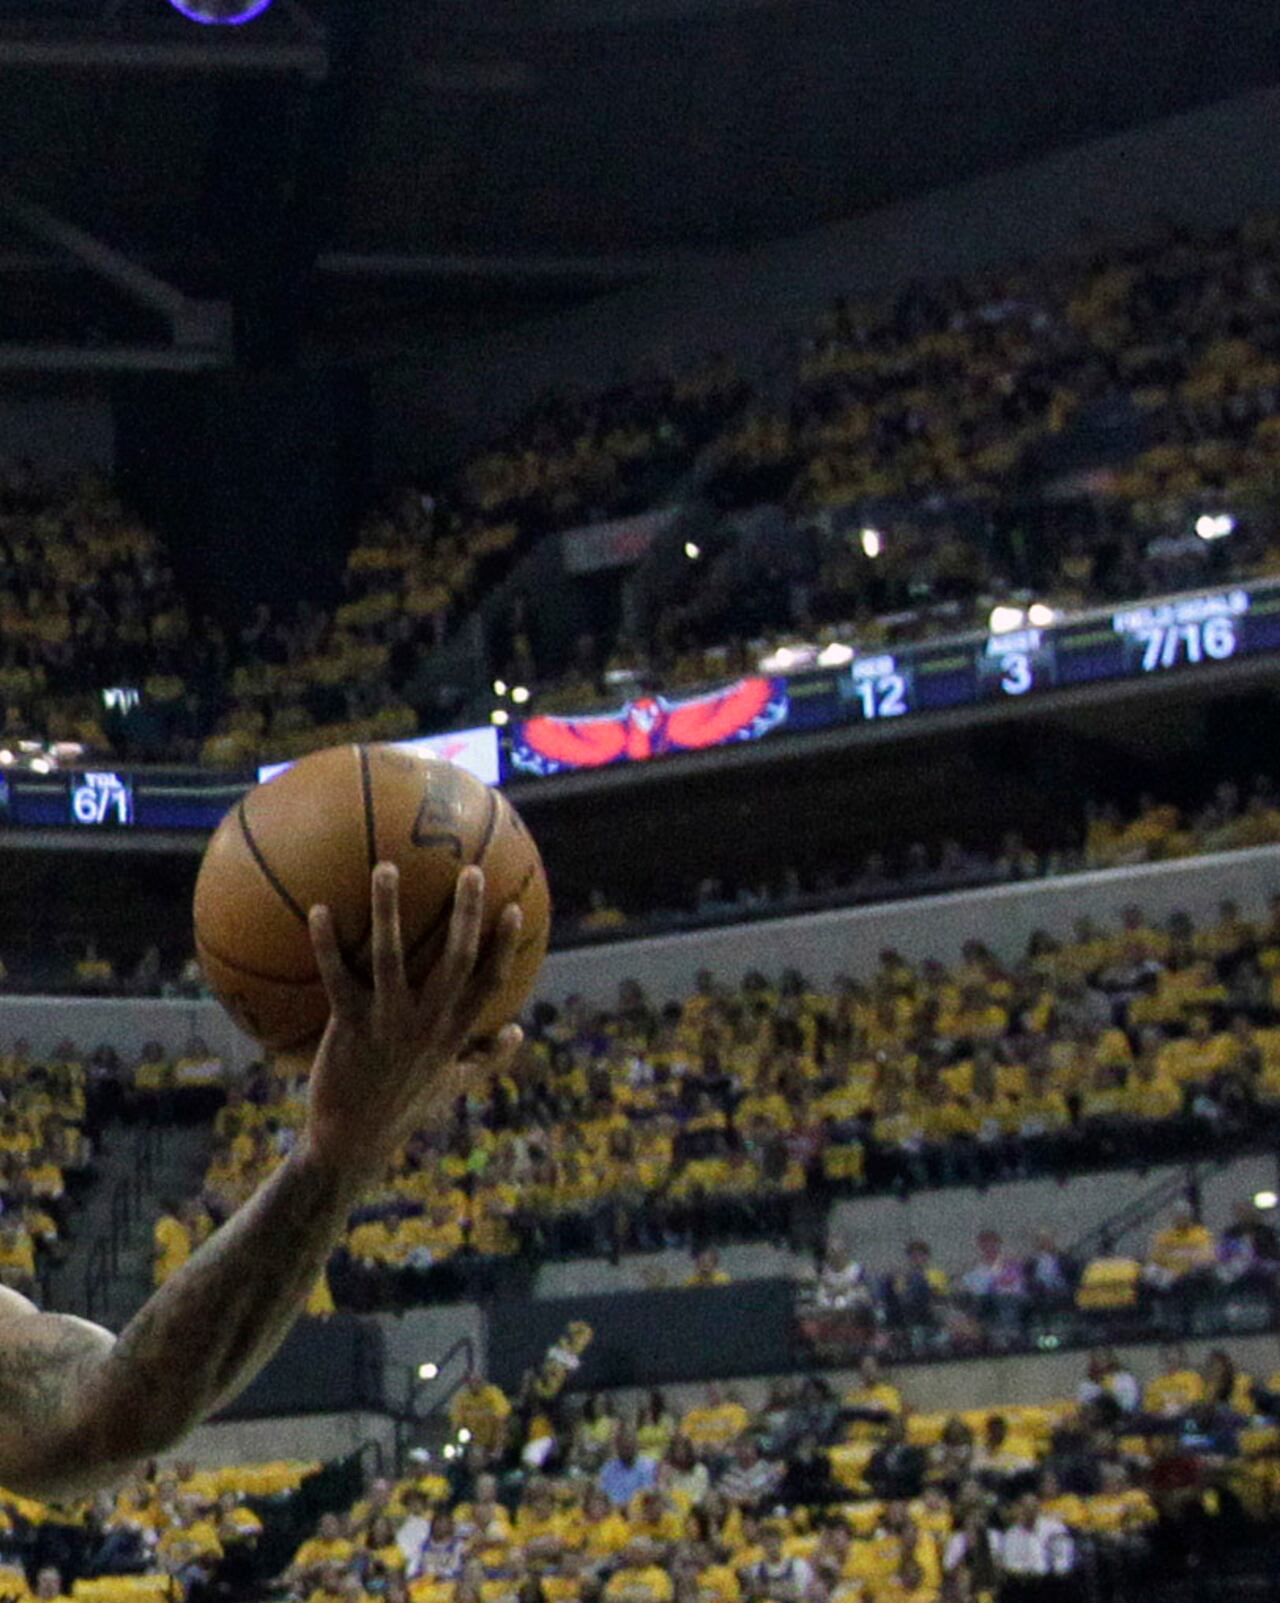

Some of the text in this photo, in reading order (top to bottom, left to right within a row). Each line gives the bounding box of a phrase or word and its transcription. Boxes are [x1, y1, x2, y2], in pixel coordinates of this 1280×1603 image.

[1141, 616, 1236, 671] 7/16
[1000, 652, 1033, 695] 3
[856, 673, 909, 719] 12
[73, 786, 128, 824] 6/1
